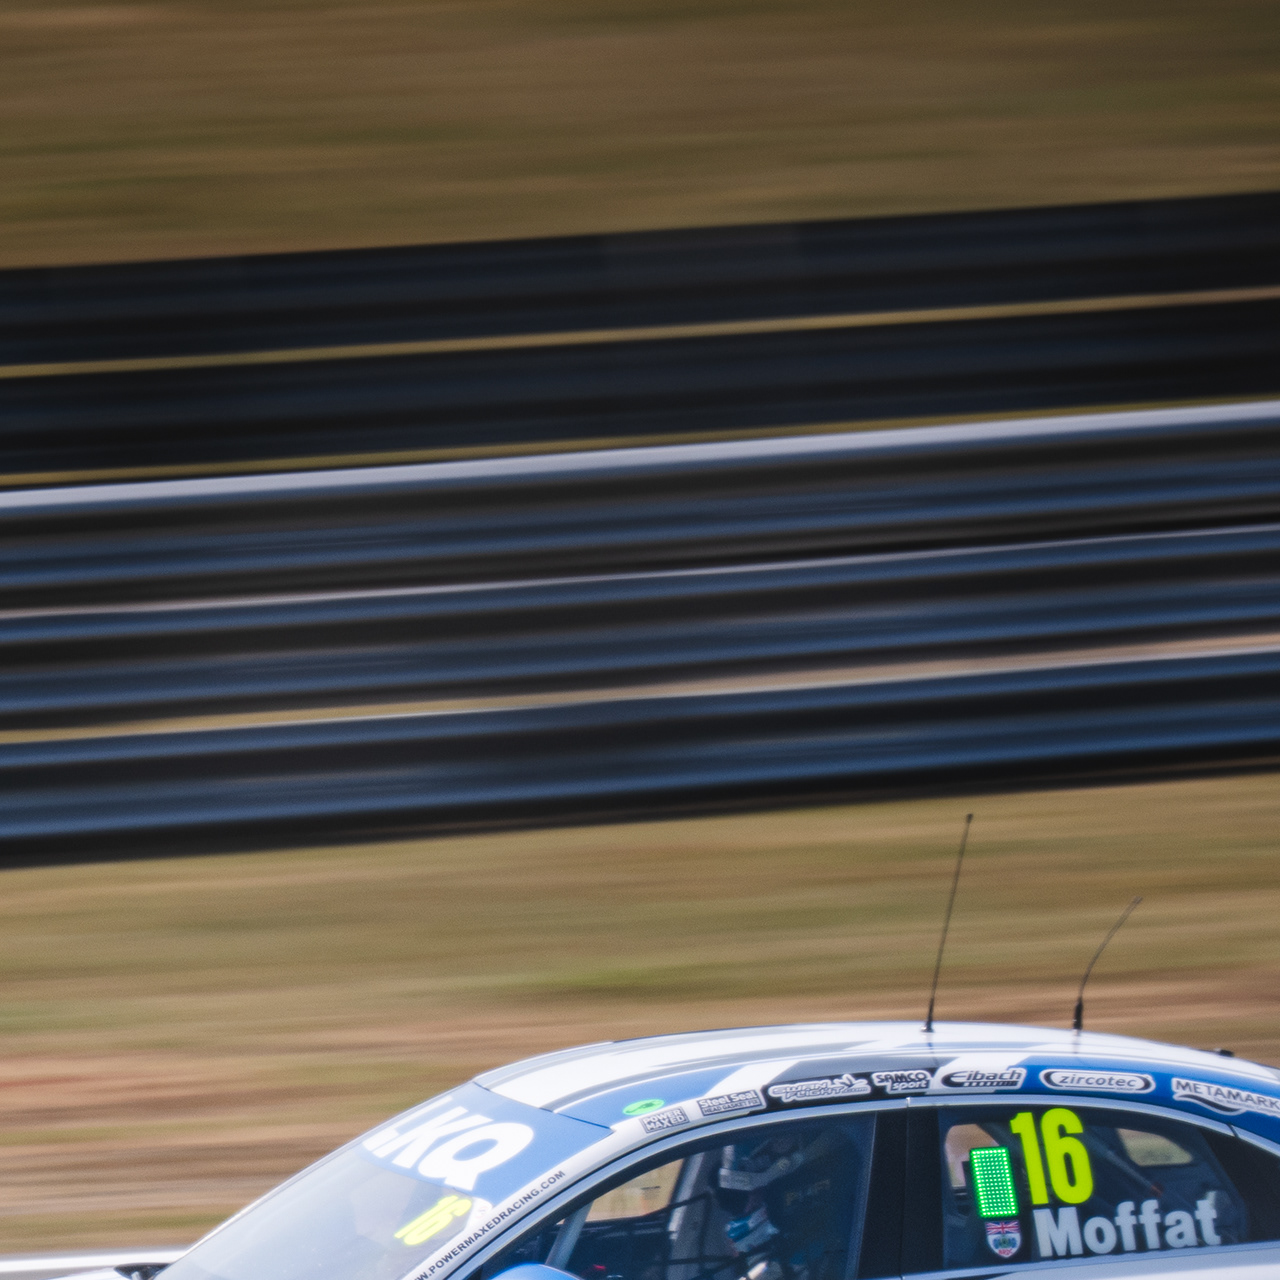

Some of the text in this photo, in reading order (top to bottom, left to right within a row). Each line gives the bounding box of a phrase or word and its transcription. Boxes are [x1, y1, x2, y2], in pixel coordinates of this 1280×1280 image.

[875, 1072, 927, 1083] SAMCO
[893, 1080, 928, 1092] sport
[941, 1070, 1023, 1087] Eibach
[1059, 1073, 1137, 1088] zircotec
[699, 1090, 758, 1108] Steel Seal
[1176, 1079, 1280, 1111] METAMARK
[643, 1109, 682, 1125] POWER
[646, 1116, 687, 1131] MAXED
[362, 1096, 534, 1191] LKQ
[1010, 1107, 1093, 1205] 16
[1033, 1191, 1221, 1258] Moffat
